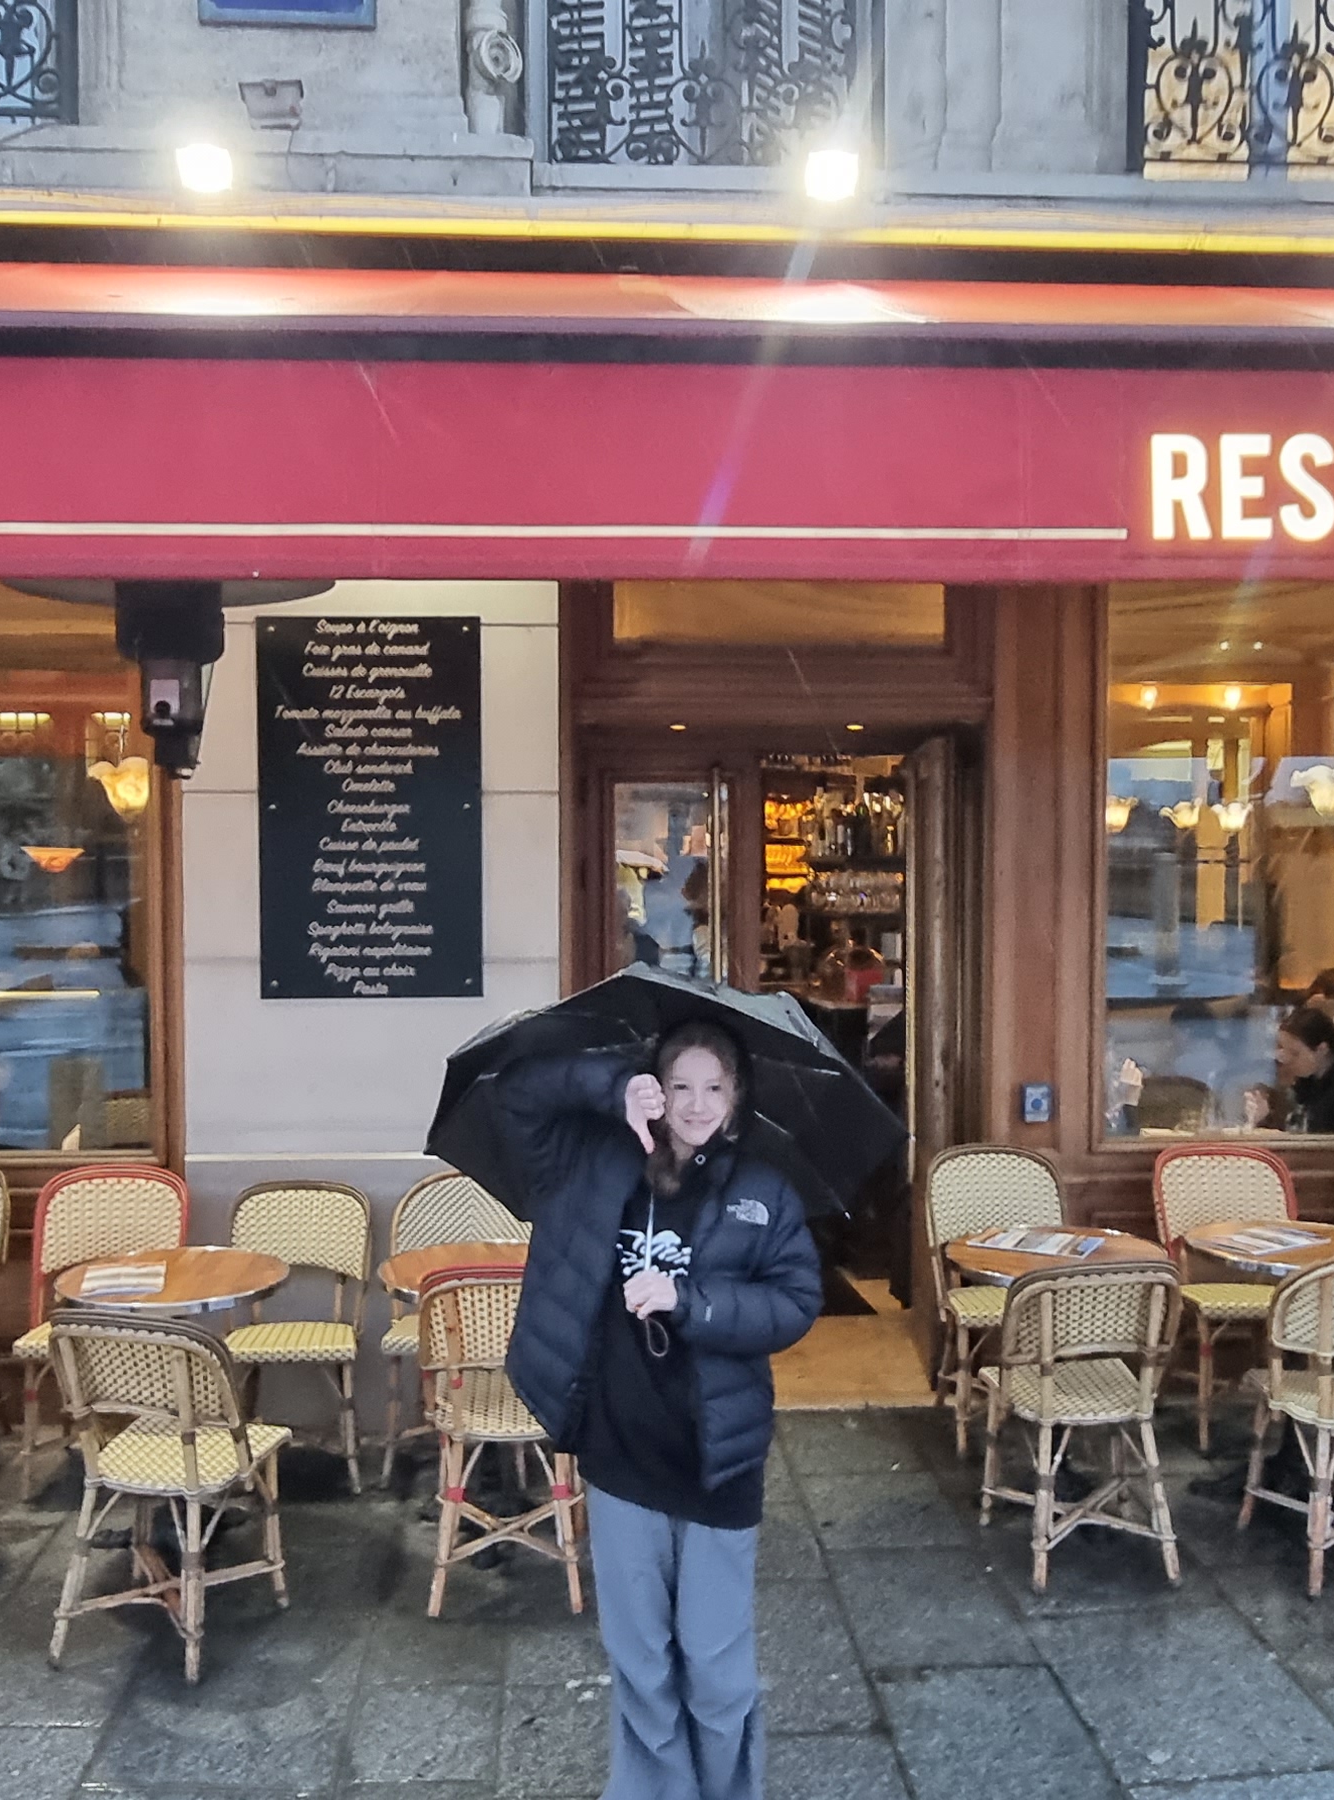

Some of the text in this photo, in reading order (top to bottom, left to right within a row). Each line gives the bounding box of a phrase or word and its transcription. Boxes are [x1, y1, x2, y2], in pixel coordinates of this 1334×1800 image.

[316, 619, 355, 636] Soupe
[356, 621, 366, 634] à
[331, 645, 362, 662] gras
[364, 641, 381, 656] de
[382, 641, 431, 656] canard
[302, 662, 433, 684] Cuisses de grenouille
[329, 684, 406, 706] 12 Escargots
[324, 723, 369, 738] Salade
[296, 741, 343, 756] Assiette
[345, 742, 362, 756] de
[323, 759, 413, 775] Club sandwich
[341, 777, 396, 793] Omelette
[319, 836, 420, 854] Cuisse de poulet
[312, 878, 427, 894] Blanquette de veau
[326, 899, 377, 914] Saumon
[307, 921, 367, 942] Spaghetti
[324, 963, 361, 982] Pizza
[382, 962, 416, 977] choix
